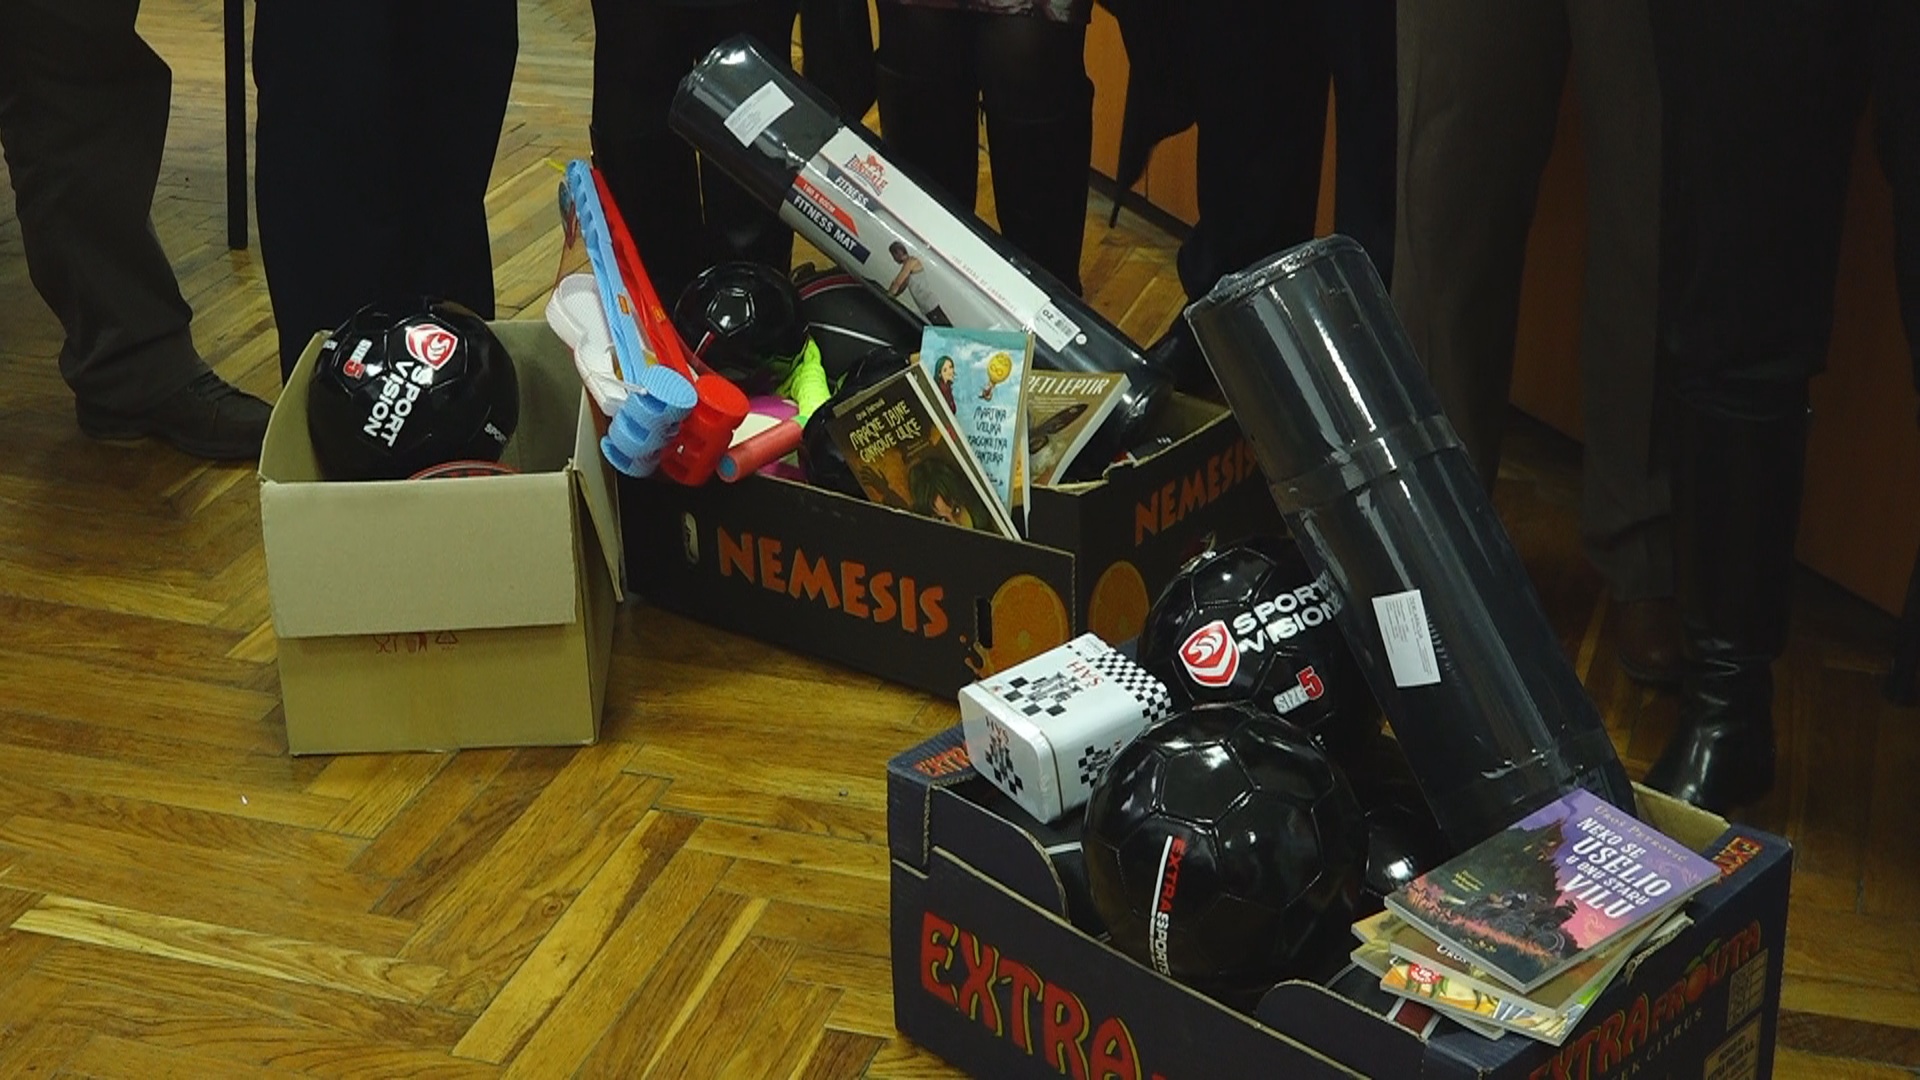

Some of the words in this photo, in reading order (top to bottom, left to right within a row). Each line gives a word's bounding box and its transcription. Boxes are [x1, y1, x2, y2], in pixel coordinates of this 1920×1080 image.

[834, 176, 869, 206] FITNESS
[793, 195, 834, 233] FITNESS
[834, 229, 858, 251] MAT
[363, 361, 414, 437] VISION
[380, 365, 434, 448] SPORT
[882, 400, 910, 428] TAJNE
[1053, 377, 1110, 395] LEPTIR
[1134, 438, 1258, 547] NEMESIS
[717, 526, 949, 638] NEMESIS
[1233, 569, 1334, 635] SPORT
[1239, 592, 1342, 653] VISION
[1296, 665, 1324, 701] 5
[913, 740, 972, 778] EXTR
[1577, 817, 1623, 845] NEKO
[1621, 843, 1646, 859] SE
[1158, 838, 1187, 912] EXTRA
[1566, 855, 1579, 864] U
[1577, 861, 1605, 879] ONU
[1603, 877, 1650, 905] STARU
[1573, 836, 1671, 897] USELIO
[1564, 874, 1636, 918] VILU
[921, 911, 1142, 1080] EXTRA
[1649, 1007, 1702, 1060] CITRUS
